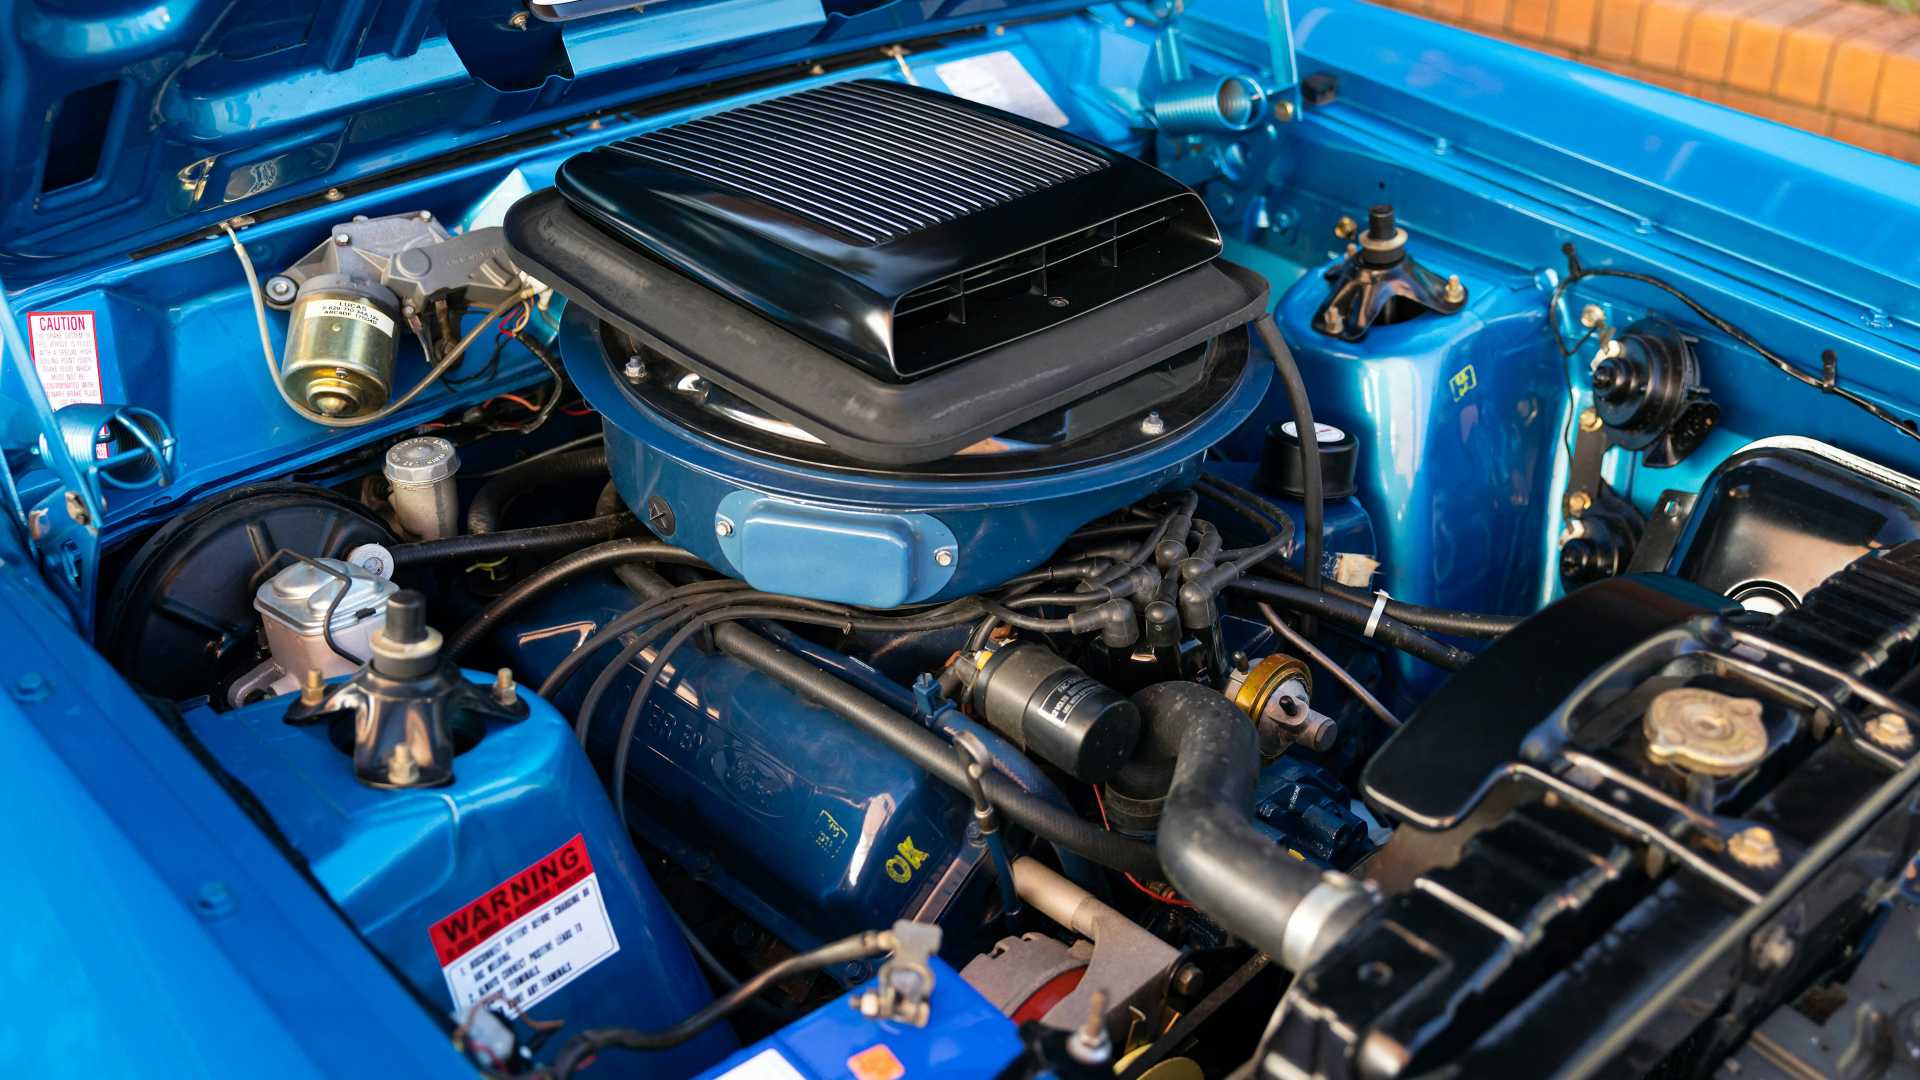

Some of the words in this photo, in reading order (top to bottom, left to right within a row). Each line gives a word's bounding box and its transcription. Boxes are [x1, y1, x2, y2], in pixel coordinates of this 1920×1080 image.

[339, 301, 367, 311] LUCAS
[40, 316, 85, 331] CAUTION
[886, 835, 929, 883] OK
[442, 847, 579, 942] WARNING
